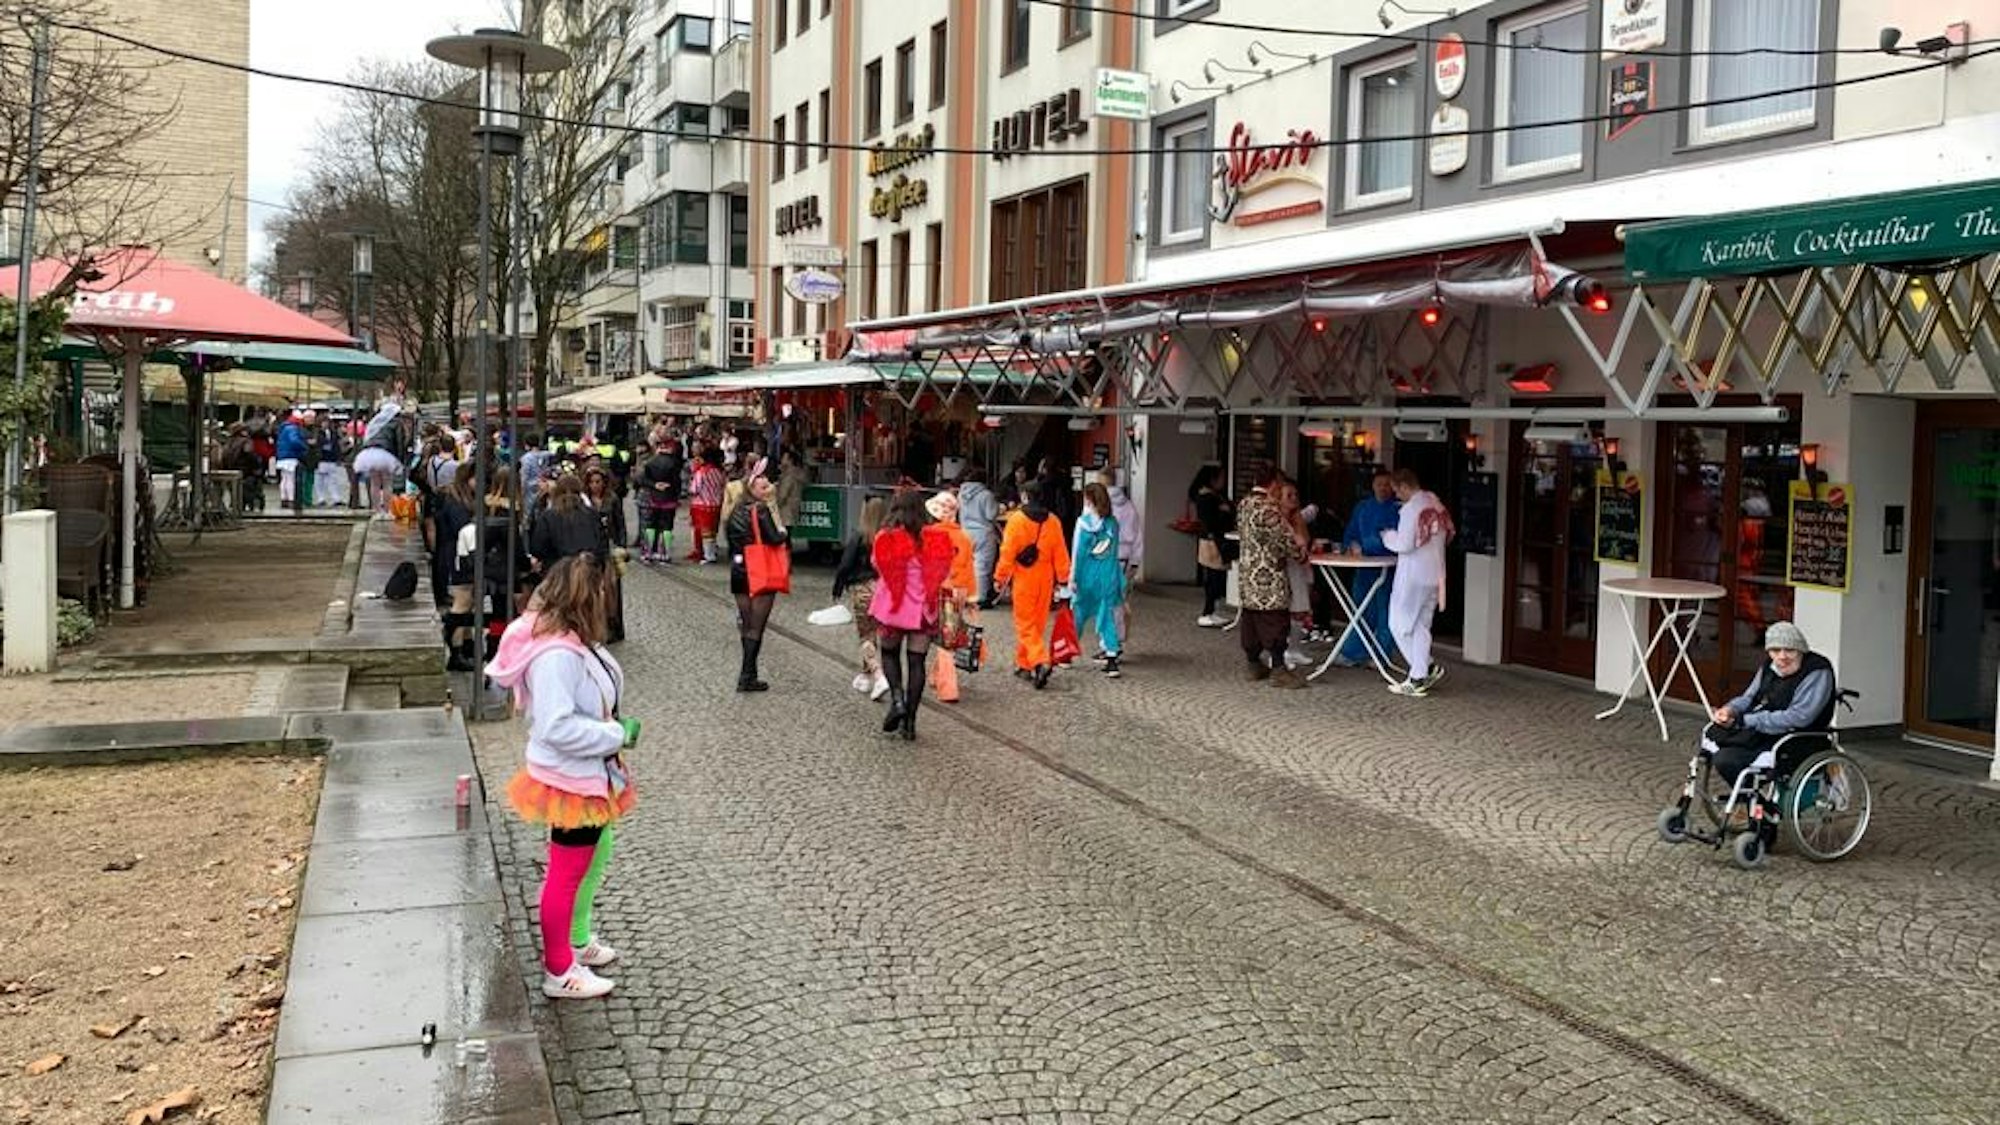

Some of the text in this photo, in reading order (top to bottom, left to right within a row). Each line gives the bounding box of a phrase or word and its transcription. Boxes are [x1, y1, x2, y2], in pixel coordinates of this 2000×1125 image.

[992, 88, 1088, 161] HOTEL
[775, 195, 822, 236] HOTEL
[792, 249, 841, 263] HOTEL
[1701, 229, 1780, 266] Karibik
[1794, 216, 1936, 255] Cocktailbar
